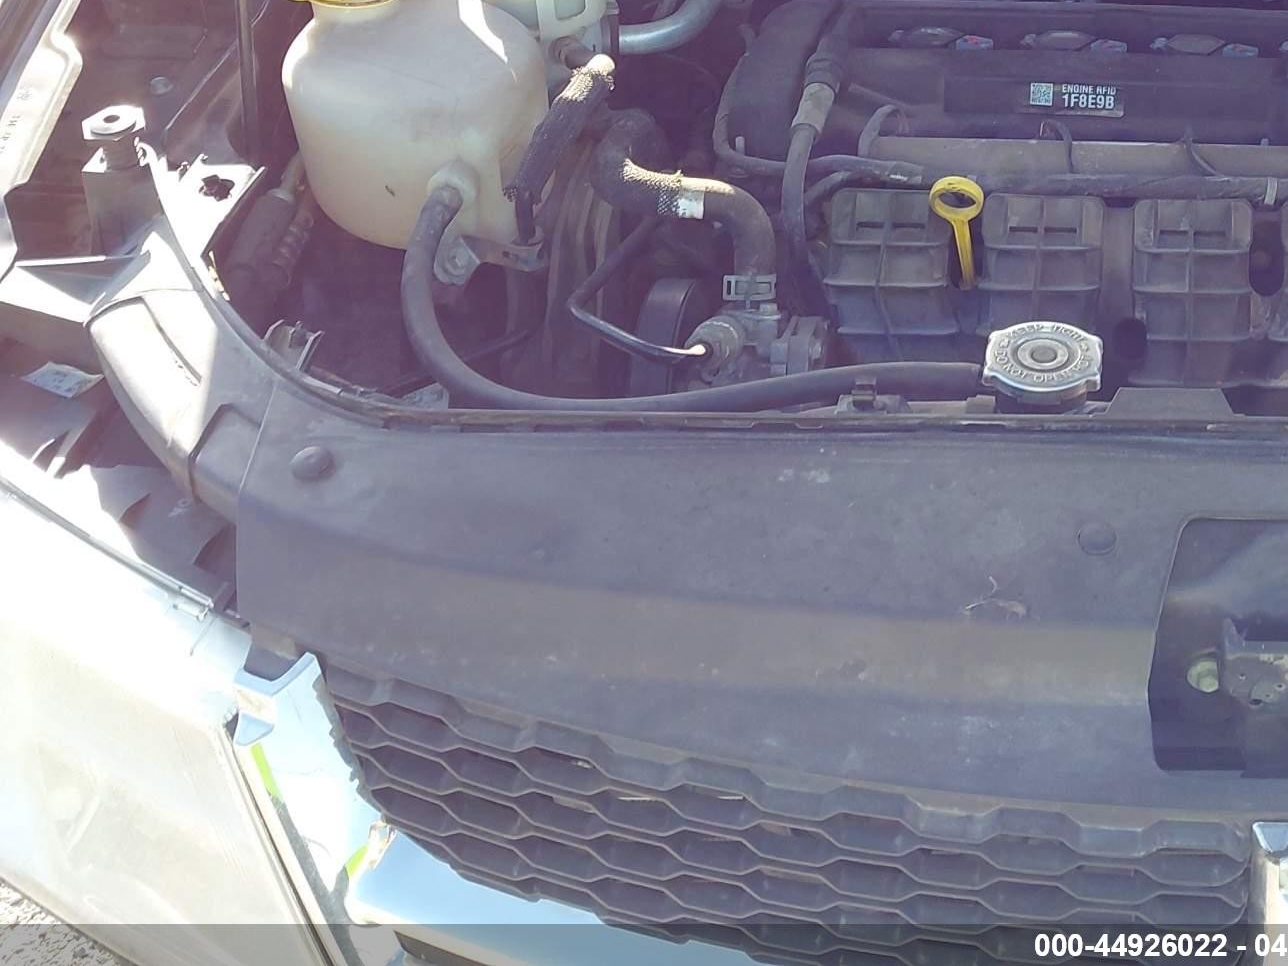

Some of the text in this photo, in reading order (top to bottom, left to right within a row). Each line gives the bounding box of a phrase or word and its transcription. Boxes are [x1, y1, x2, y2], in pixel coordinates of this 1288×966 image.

[1061, 83, 1117, 96] ENGINE RFID
[1061, 94, 1115, 109] 1F8E9B
